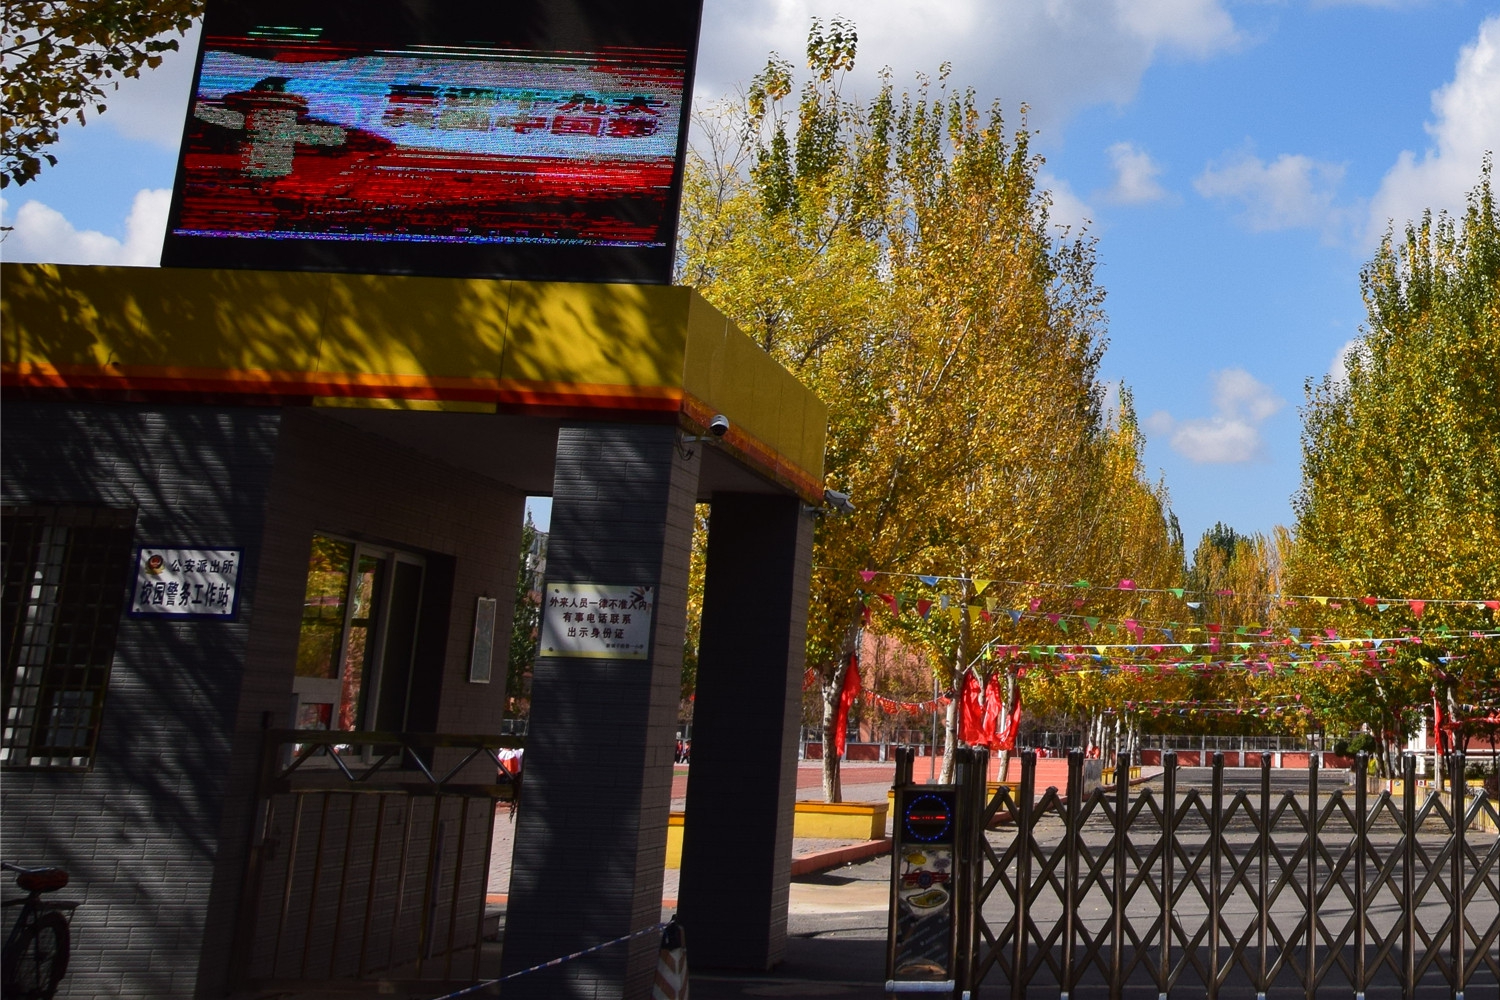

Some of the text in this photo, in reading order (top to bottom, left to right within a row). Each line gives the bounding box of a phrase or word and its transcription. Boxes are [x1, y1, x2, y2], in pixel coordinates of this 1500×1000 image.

[171, 559, 234, 574] 公安派出所
[139, 581, 230, 607] 校园警务工作站
[549, 596, 648, 611] 外来人员一律不准入内
[562, 612, 632, 625] 有事电话联系
[567, 626, 625, 640] 出示身份证
